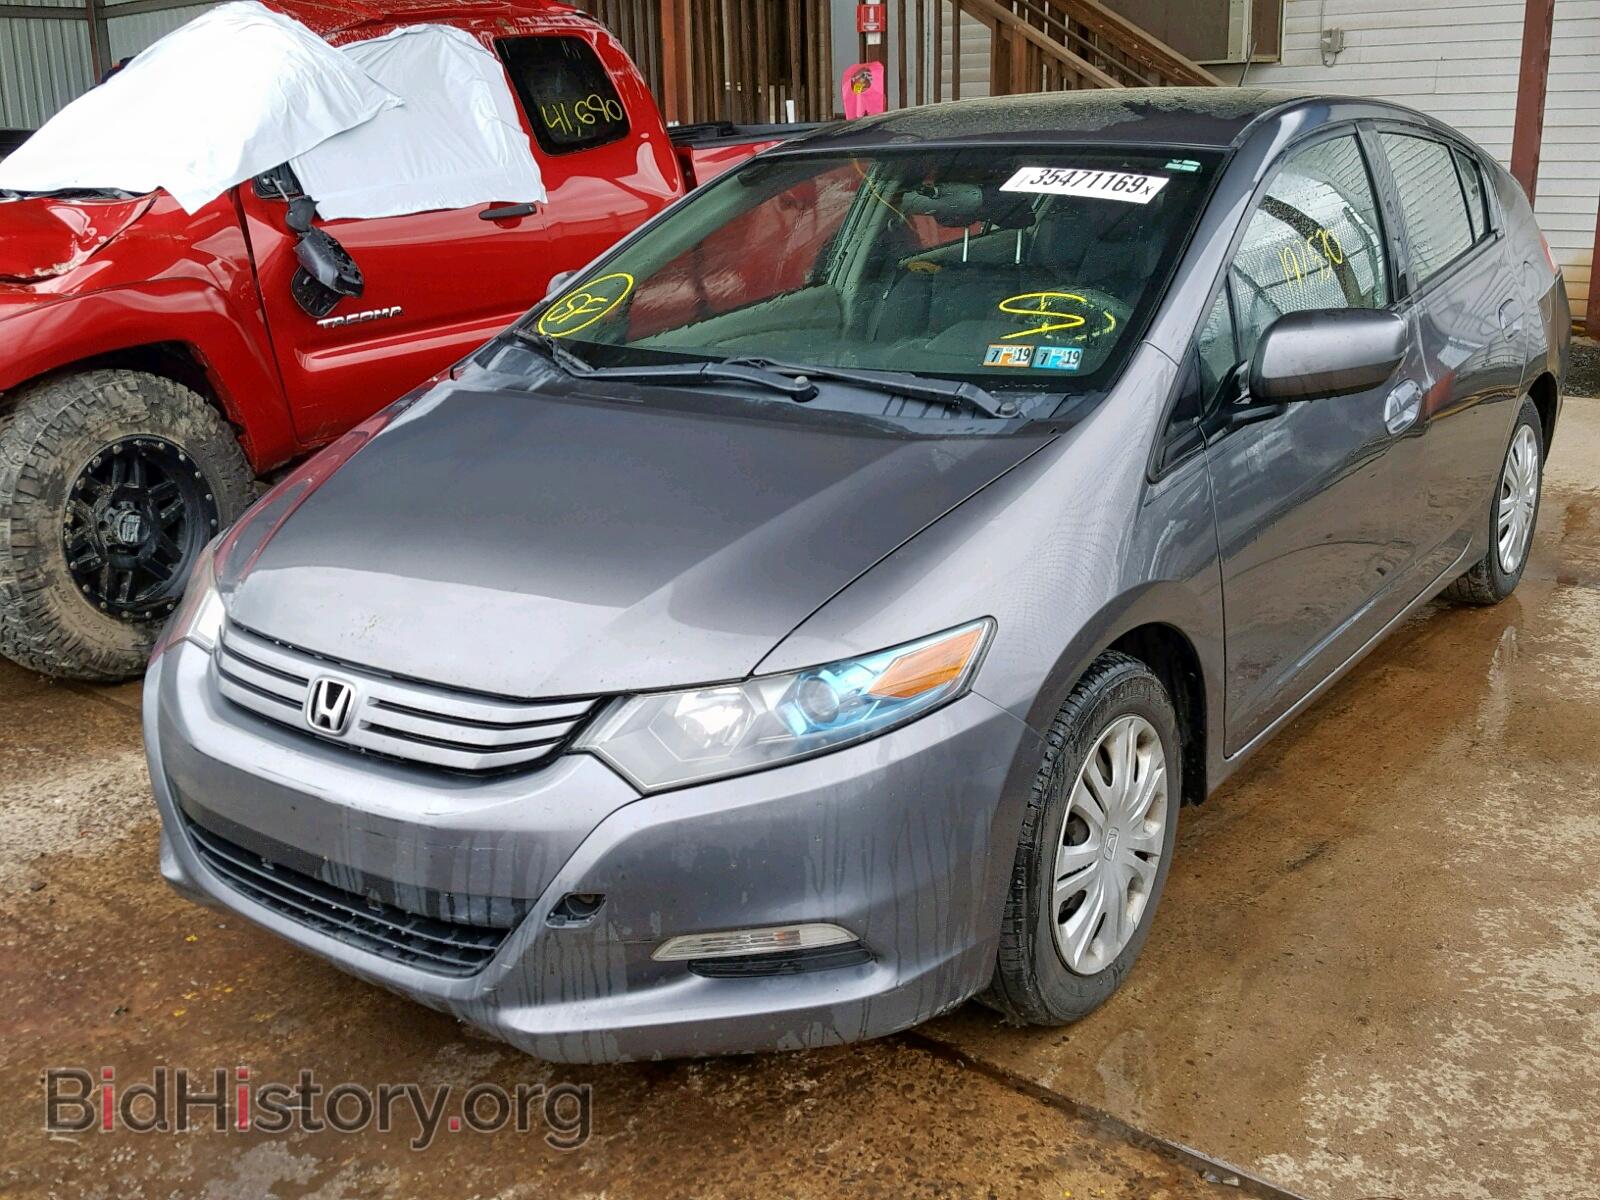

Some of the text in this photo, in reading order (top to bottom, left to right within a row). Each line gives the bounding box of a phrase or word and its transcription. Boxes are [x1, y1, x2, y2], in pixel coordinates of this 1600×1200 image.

[541, 94, 623, 137] 41,690
[991, 348, 1031, 363] 7 19
[1040, 350, 1080, 365] 7 19
